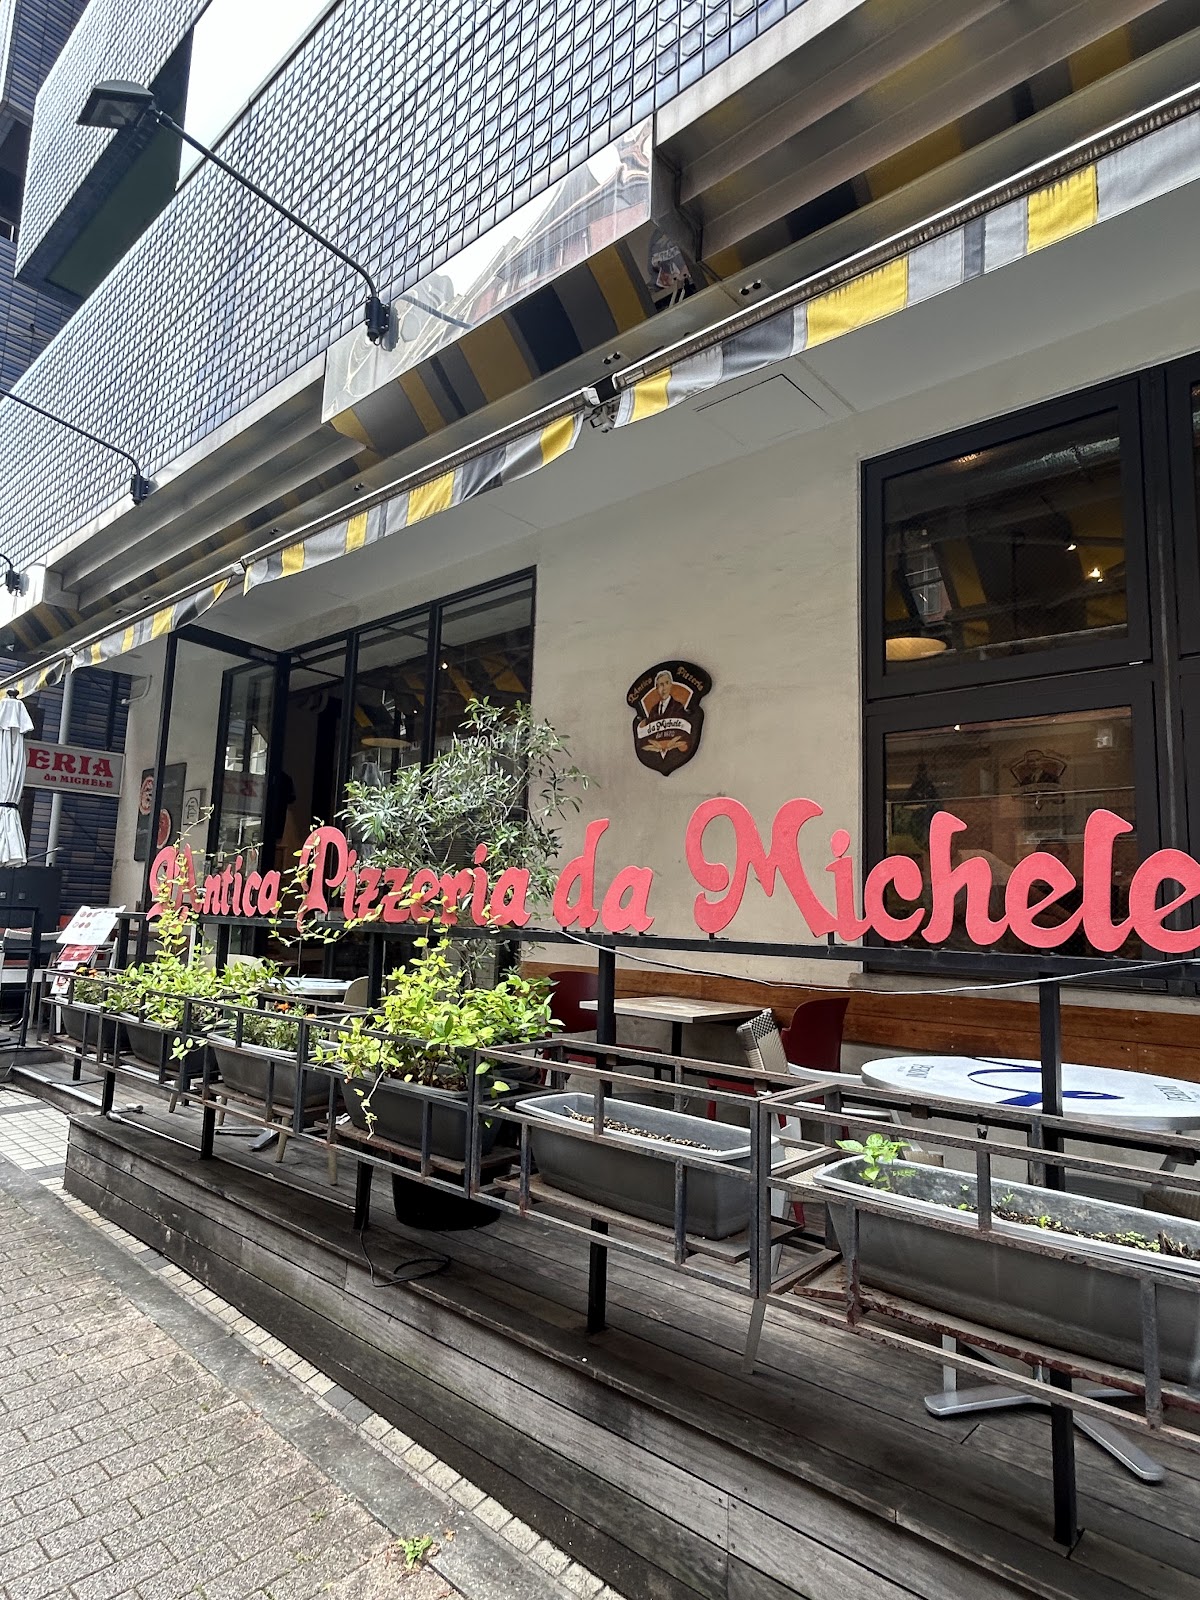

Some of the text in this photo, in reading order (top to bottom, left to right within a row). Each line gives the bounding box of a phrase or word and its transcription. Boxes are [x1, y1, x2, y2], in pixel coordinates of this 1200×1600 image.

[297, 826, 532, 932] Pizzeria
[553, 818, 655, 933] da
[685, 797, 1200, 953] Michele
